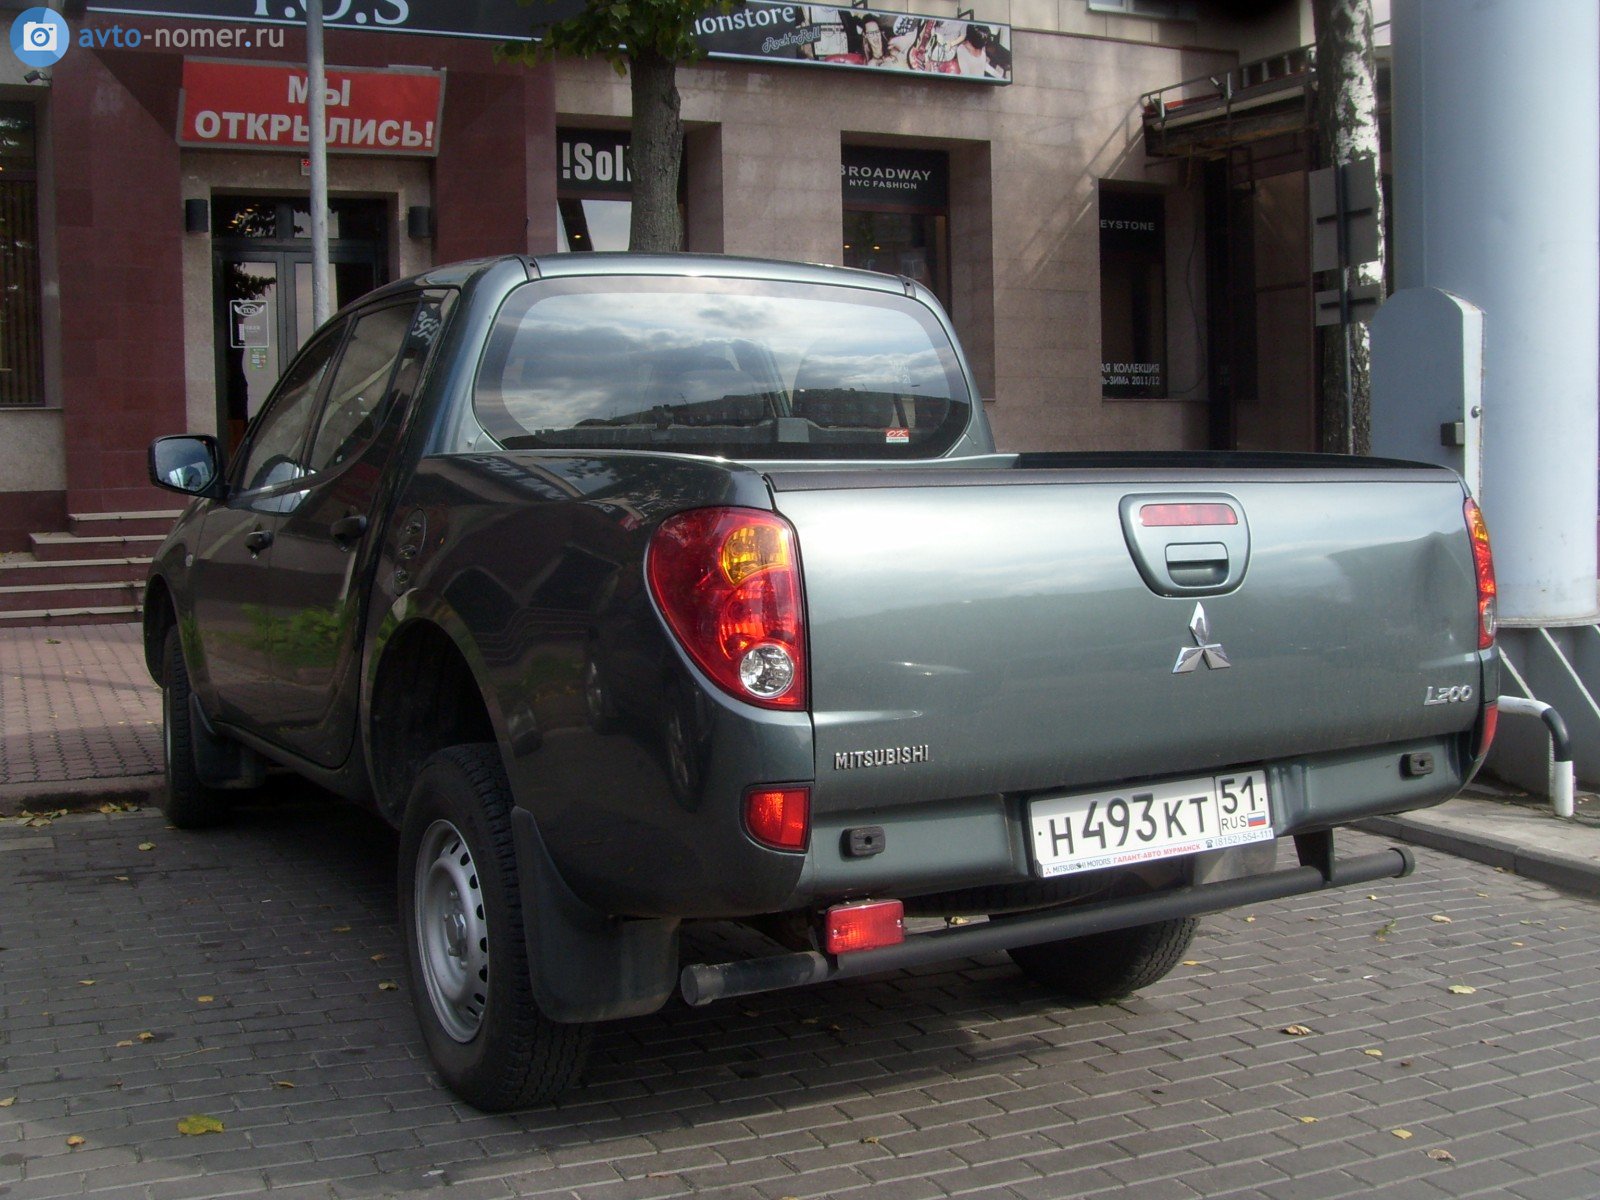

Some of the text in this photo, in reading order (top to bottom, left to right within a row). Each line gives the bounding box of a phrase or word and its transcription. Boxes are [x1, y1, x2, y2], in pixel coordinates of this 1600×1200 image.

[690, 6, 796, 36] ionstore
[288, 75, 351, 107] МЫ
[849, 179, 917, 190] NYC FASHION
[1100, 219, 1155, 231] EYSTONE
[1113, 363, 1160, 374] КОЛЛЕКЦИЯ
[1131, 375, 1160, 386] 2011/12
[1424, 684, 1473, 706] L200
[834, 744, 929, 770] MITSUBISHI
[1220, 776, 1256, 815] 51
[1221, 817, 1248, 831] RUS
[1113, 850, 1162, 864] ГАЛАНТ-АВТО
[1163, 843, 1201, 856] МУРМАНСК
